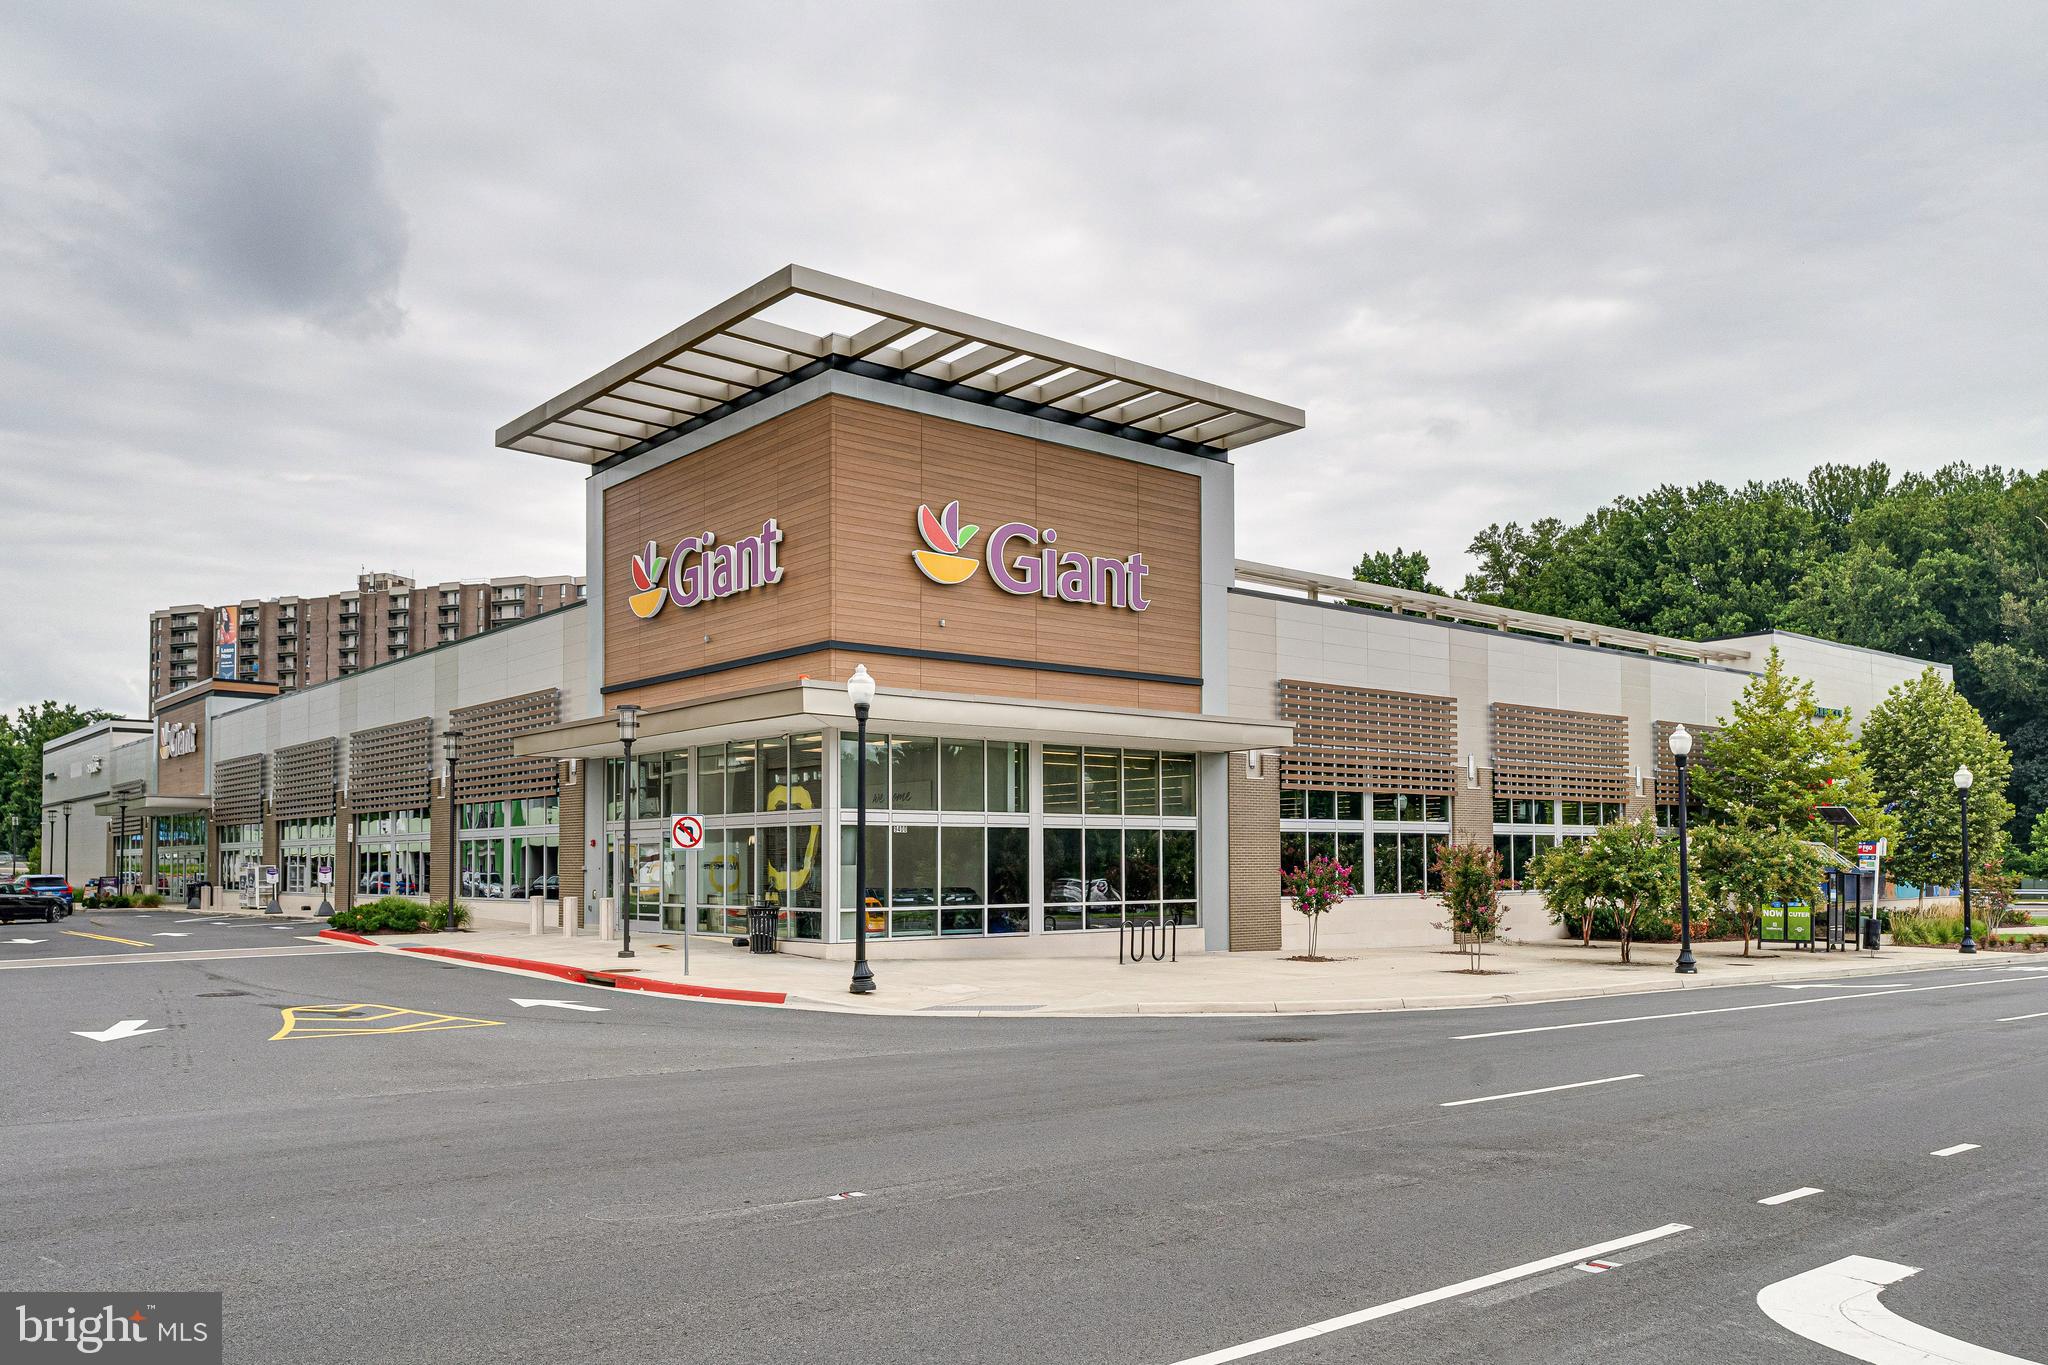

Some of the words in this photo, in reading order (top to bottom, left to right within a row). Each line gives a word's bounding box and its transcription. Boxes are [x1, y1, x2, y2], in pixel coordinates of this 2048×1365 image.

[668, 518, 785, 608] Giant
[986, 522, 1151, 612] Giant
[1763, 910, 1783, 918] NOW
